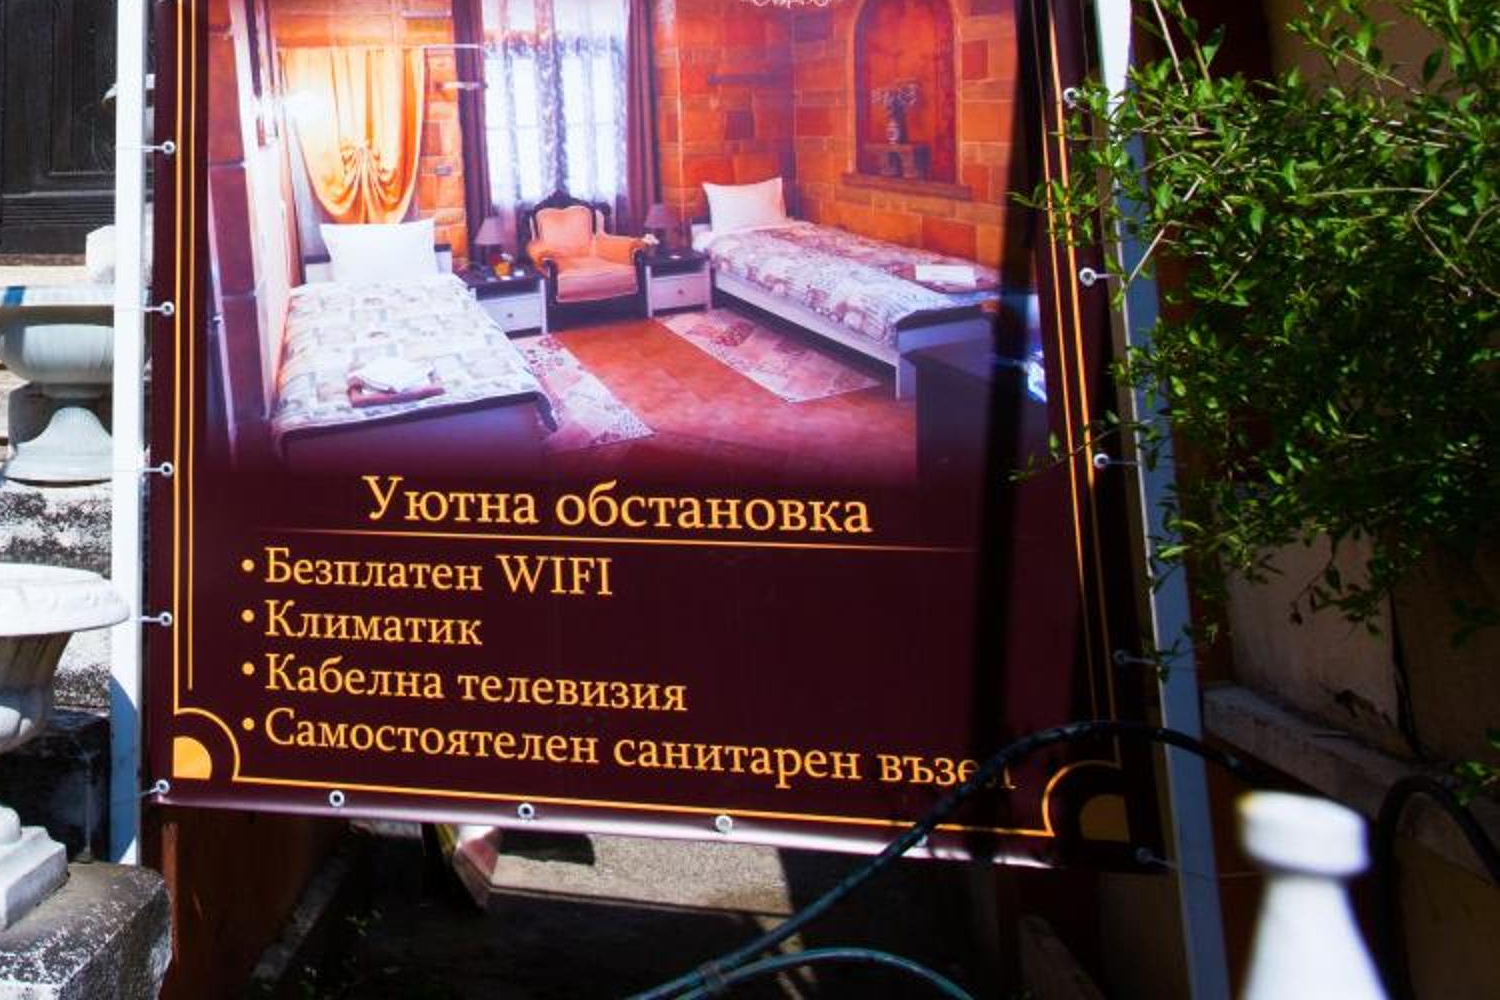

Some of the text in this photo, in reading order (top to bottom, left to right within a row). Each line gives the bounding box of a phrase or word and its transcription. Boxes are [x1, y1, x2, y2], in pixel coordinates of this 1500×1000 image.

[361, 475, 873, 534] Уютна обстановка
[264, 546, 613, 596] Безплатен WIFI
[264, 599, 483, 646] Климатик
[264, 652, 688, 712] Кабелна телевизия
[264, 707, 600, 765] Самостоятелен
[613, 736, 862, 789] санитарен
